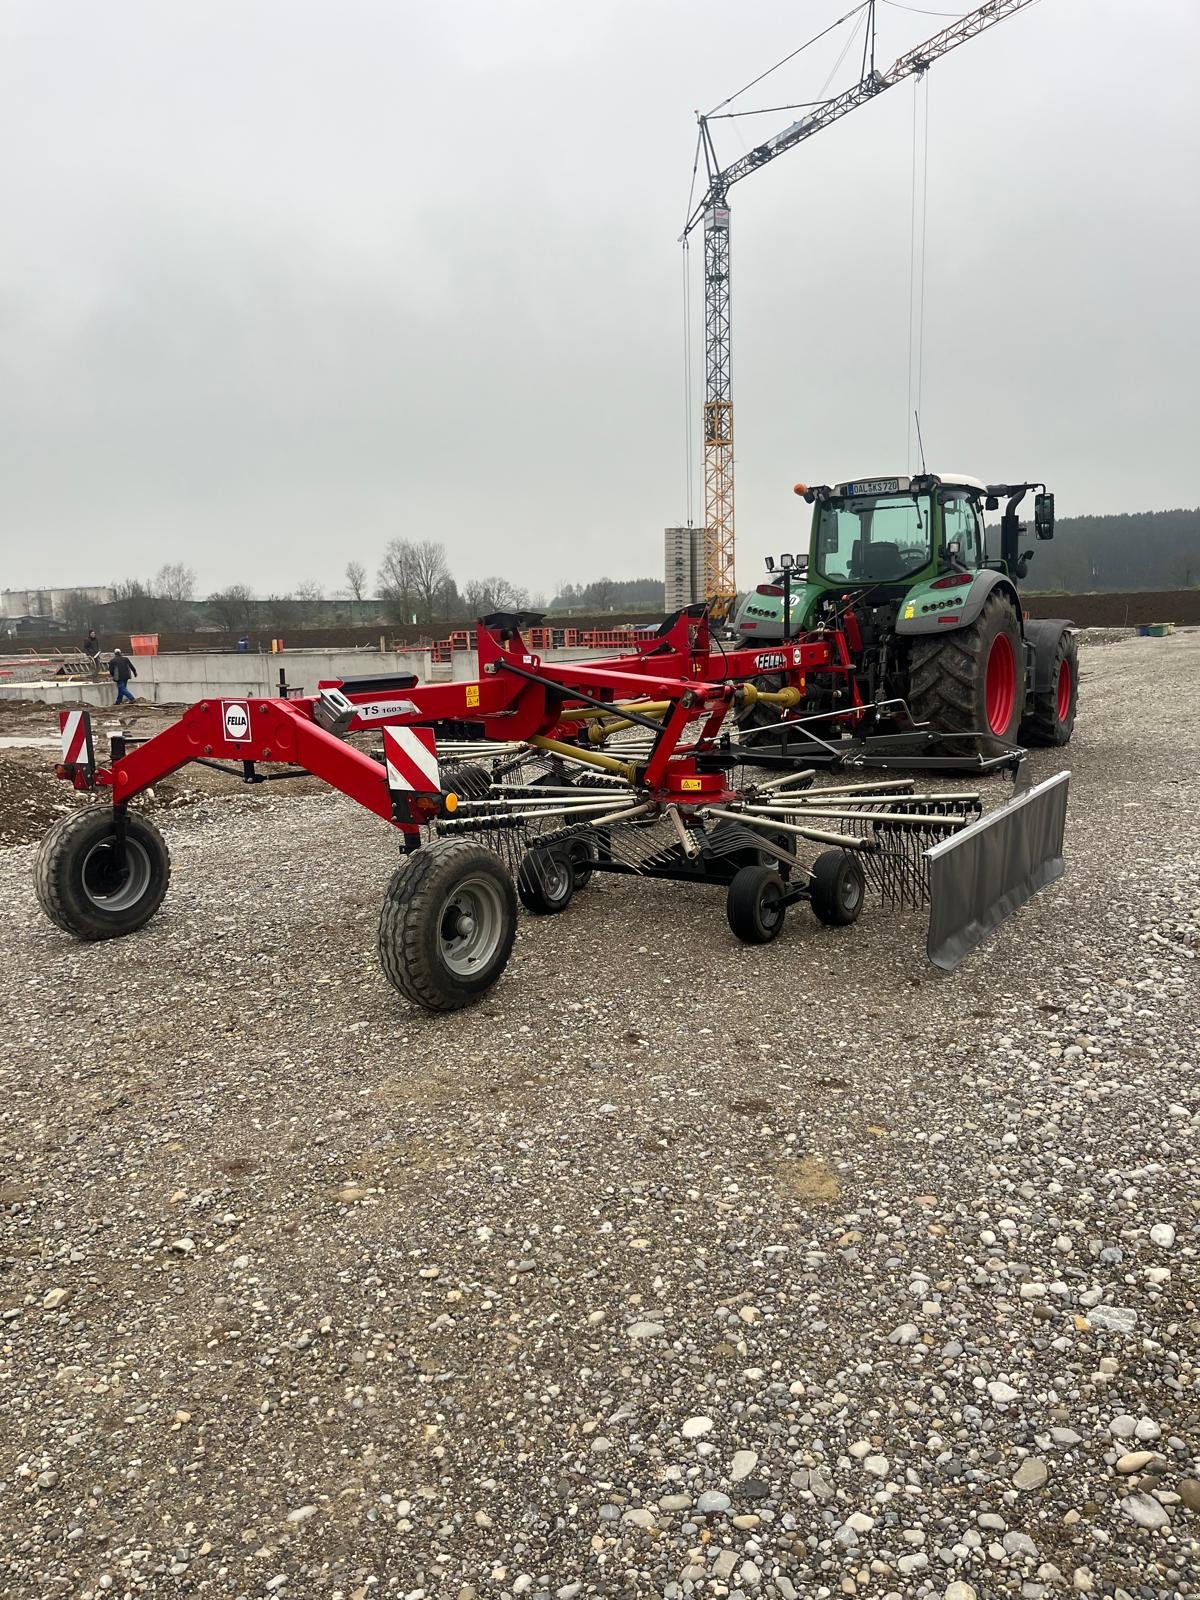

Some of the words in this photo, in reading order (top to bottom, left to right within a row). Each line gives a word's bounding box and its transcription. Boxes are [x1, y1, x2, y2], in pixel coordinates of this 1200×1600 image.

[758, 652, 784, 669] FELLA
[362, 705, 379, 716] TS
[382, 706, 402, 714] 1603
[227, 716, 247, 726] FELLA
